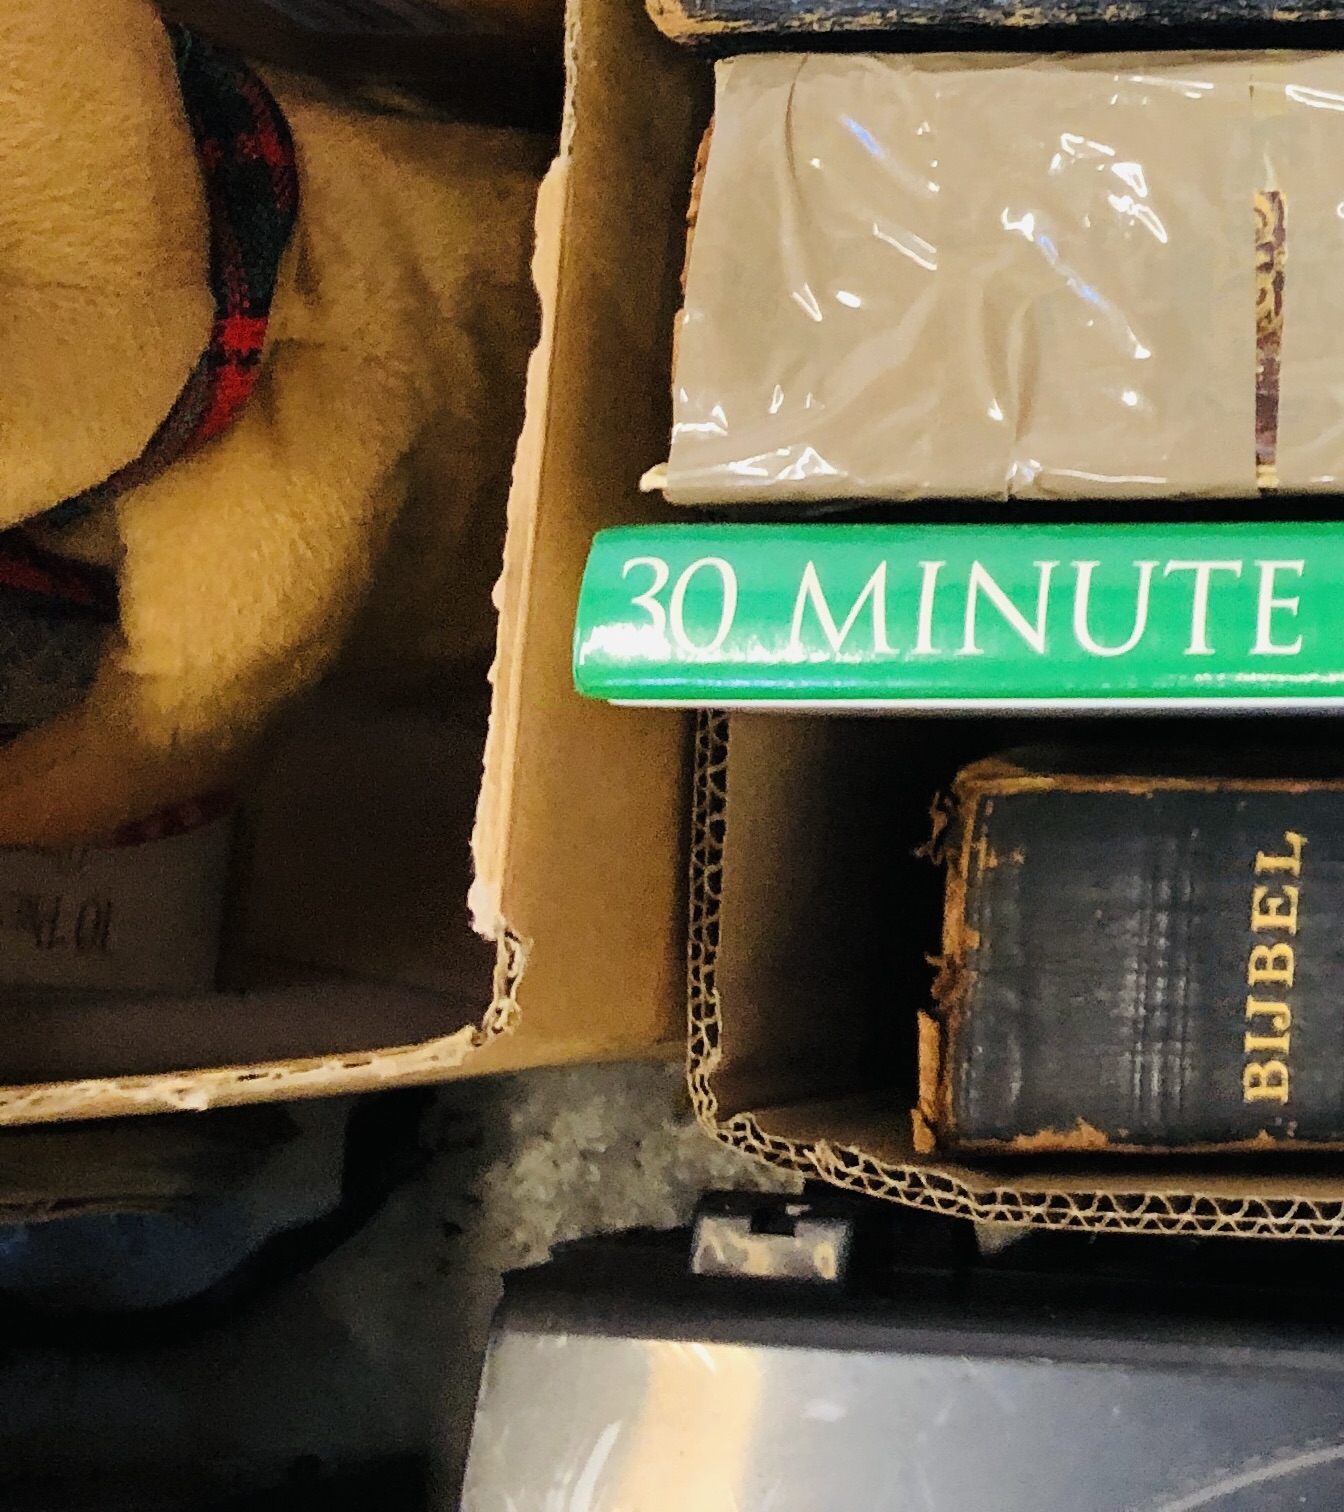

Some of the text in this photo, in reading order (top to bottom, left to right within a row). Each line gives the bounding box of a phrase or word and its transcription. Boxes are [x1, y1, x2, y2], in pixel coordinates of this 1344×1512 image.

[618, 556, 738, 658] 30
[788, 558, 1306, 658] MINUTE
[1241, 829, 1310, 1105] BIJBEL
